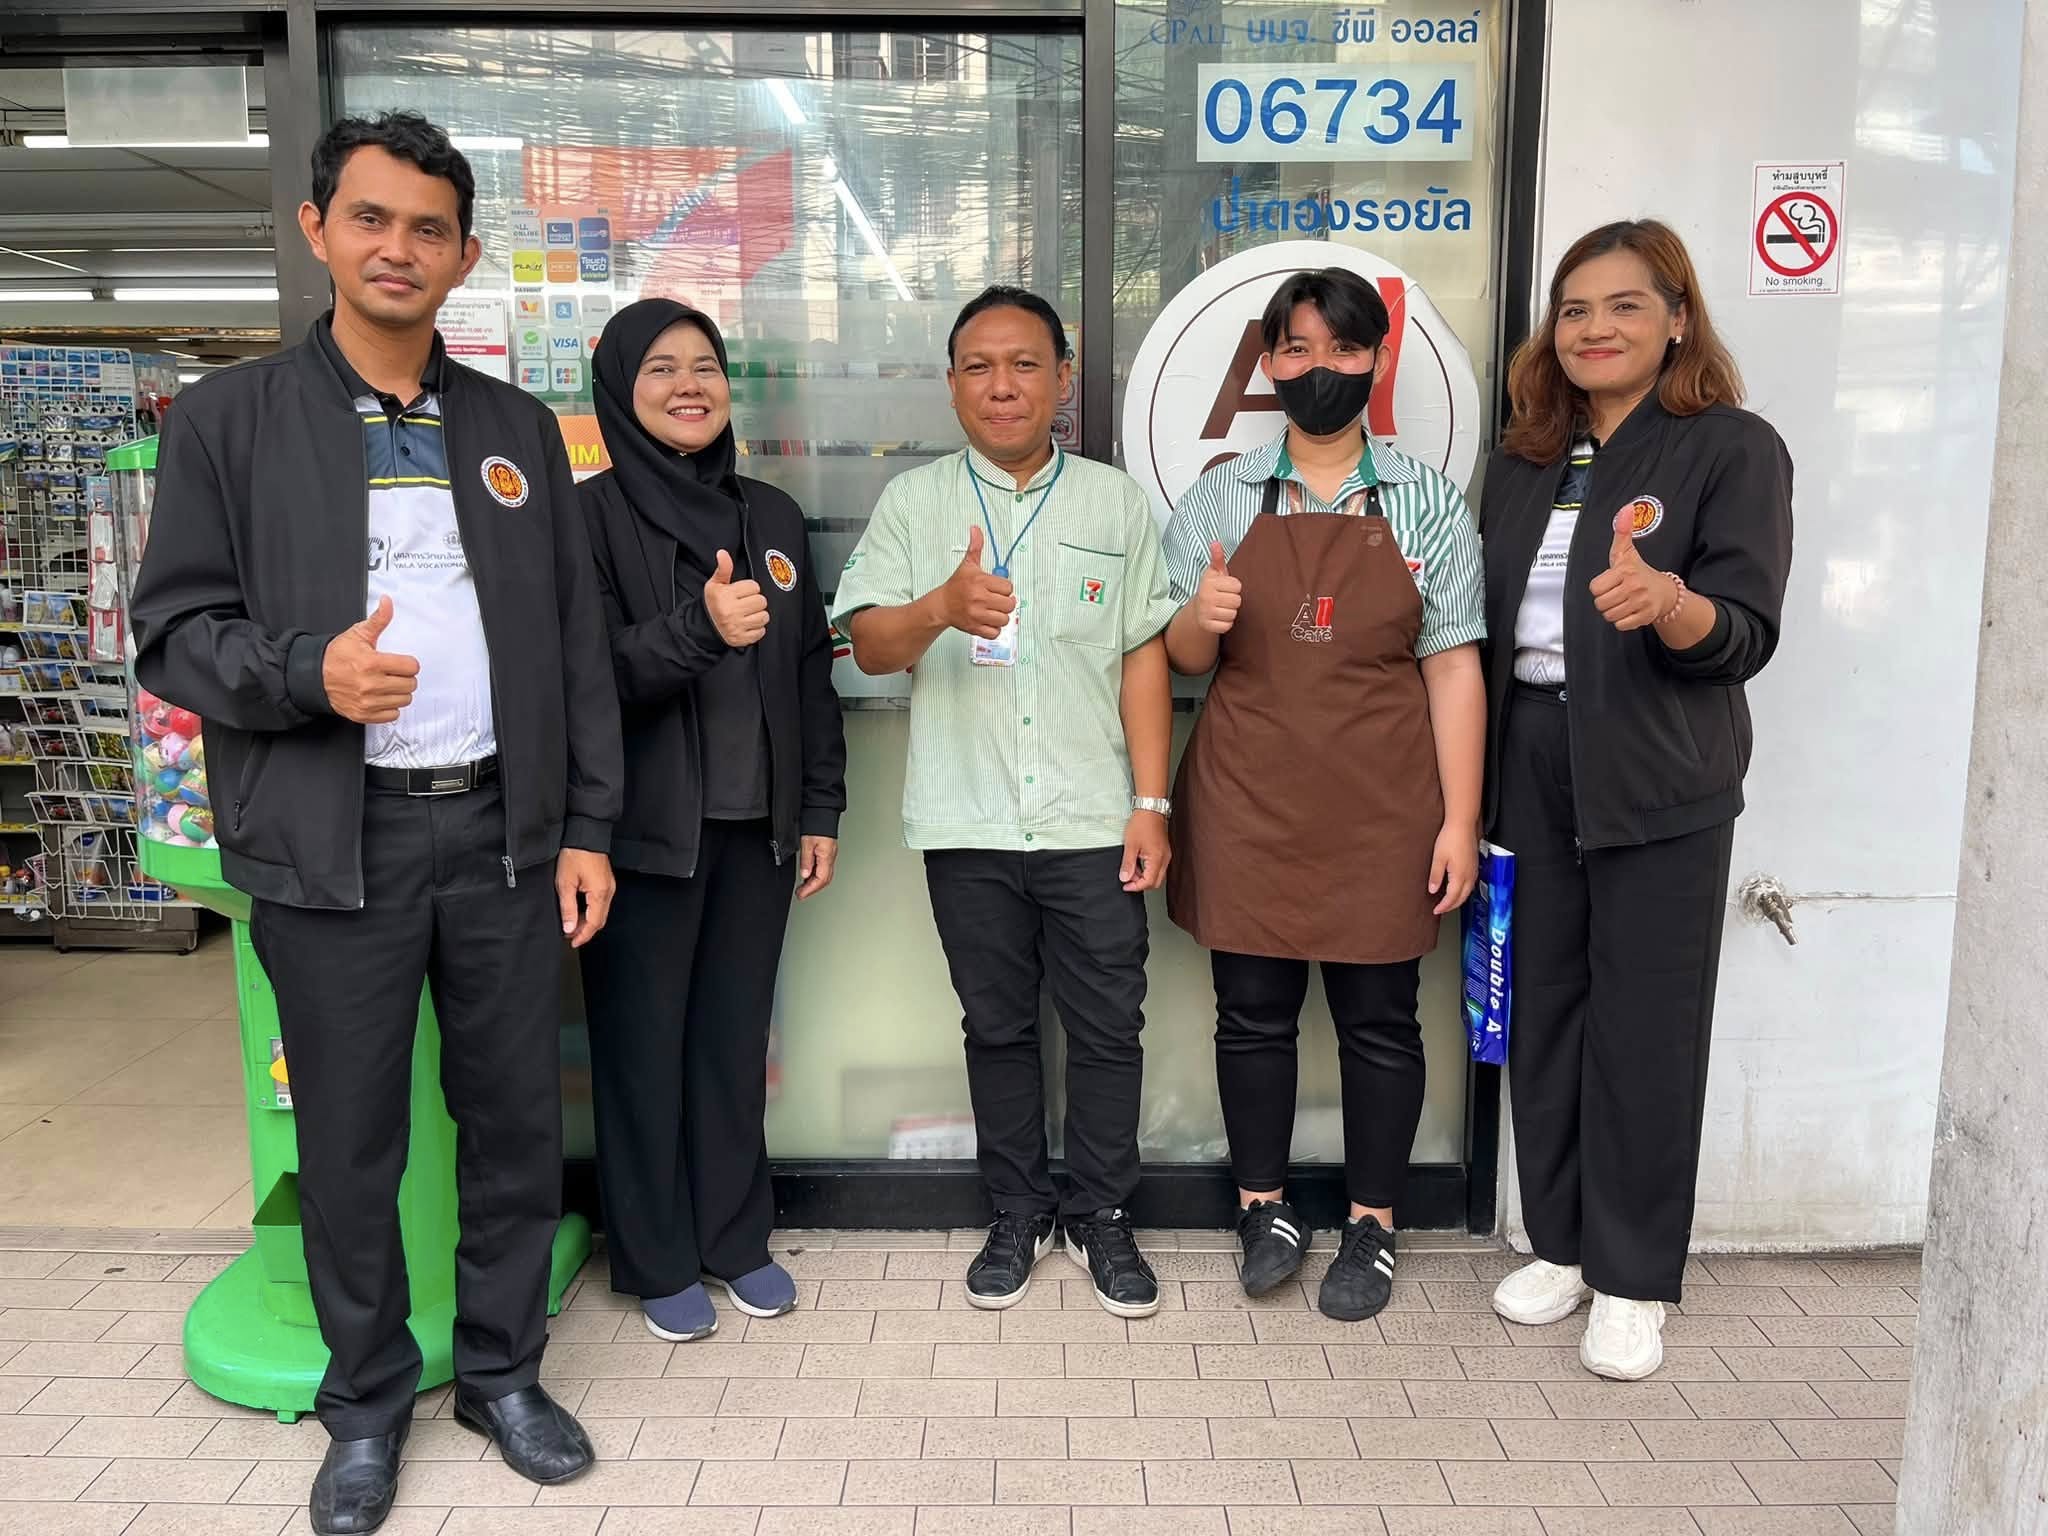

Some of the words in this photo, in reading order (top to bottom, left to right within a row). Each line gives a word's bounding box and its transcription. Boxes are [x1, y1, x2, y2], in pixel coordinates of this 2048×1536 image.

[1248, 19, 1317, 44] บมจ.
[1333, 8, 1376, 44] ซีพี
[1391, 9, 1481, 44] ออลล์
[1204, 77, 1463, 145] 06734
[1212, 175, 1472, 232] ป่าตองรอยัล
[1765, 277, 1780, 286] No
[1783, 276, 1823, 287] smoking
[553, 338, 579, 348] VISA
[1489, 926, 1507, 1010] Double
[1486, 1017, 1502, 1033] A
